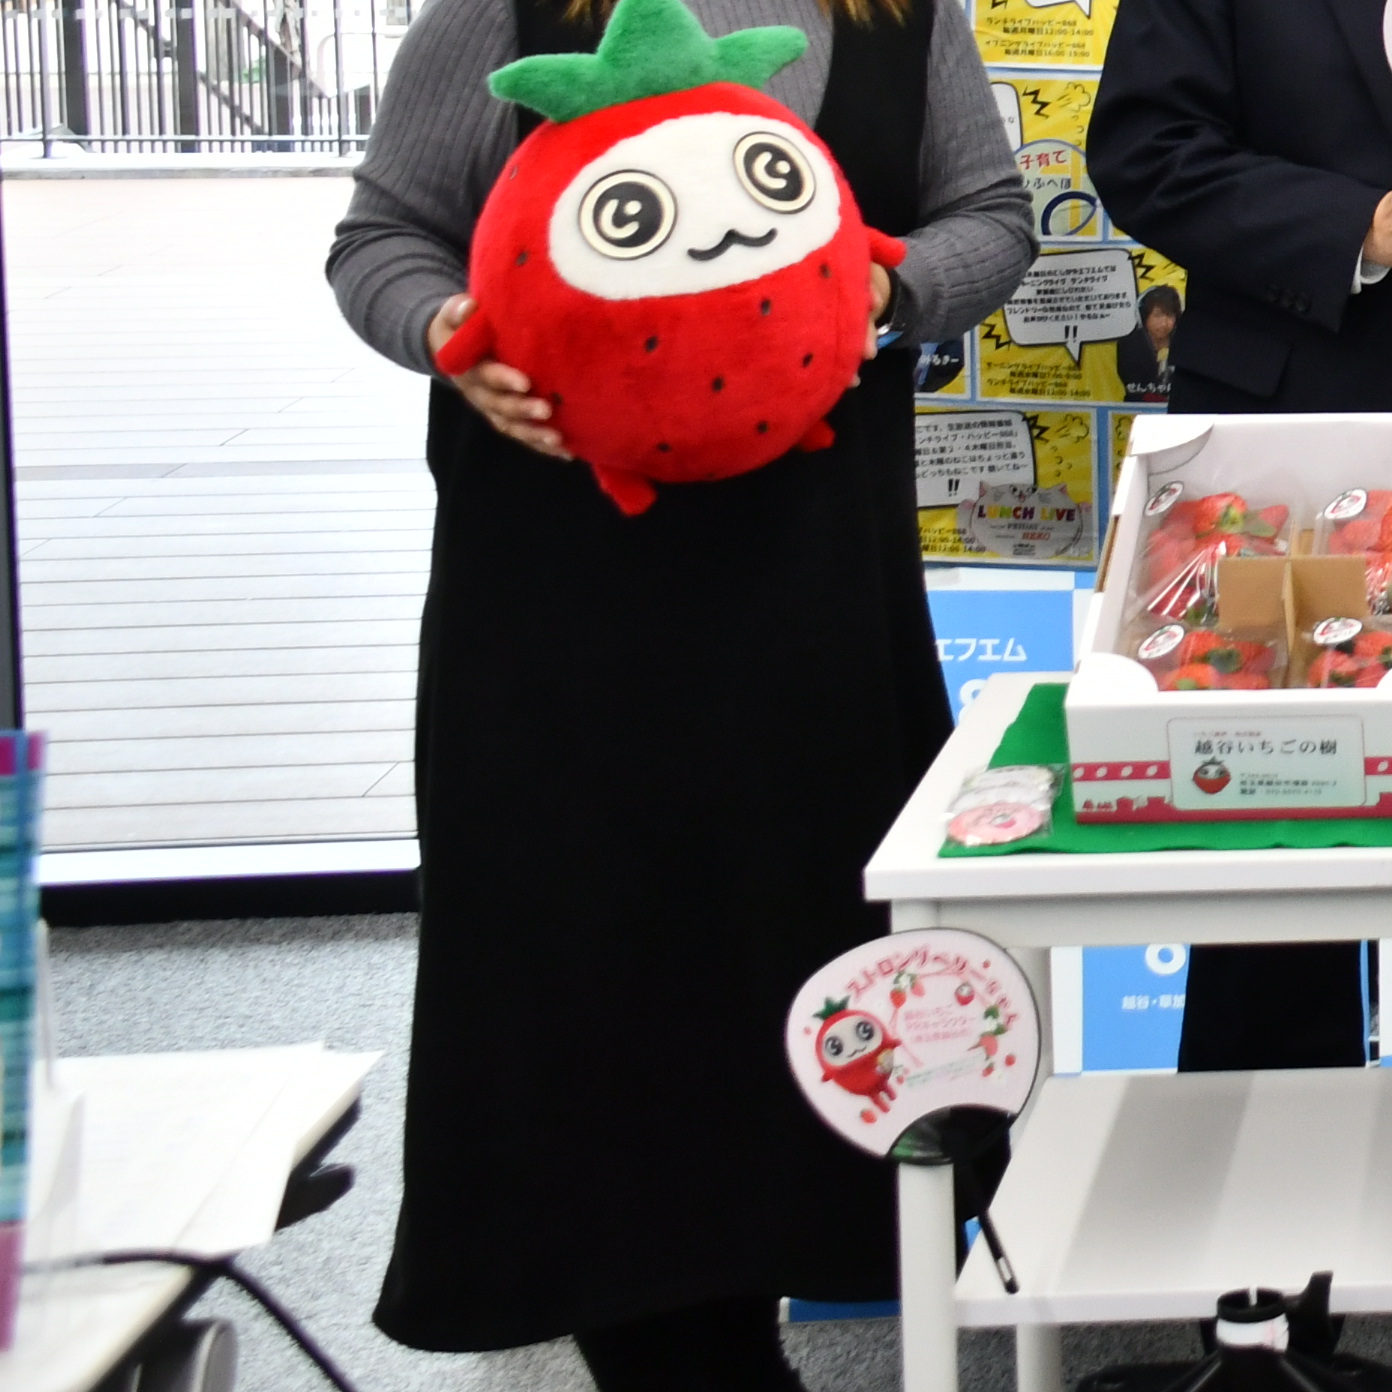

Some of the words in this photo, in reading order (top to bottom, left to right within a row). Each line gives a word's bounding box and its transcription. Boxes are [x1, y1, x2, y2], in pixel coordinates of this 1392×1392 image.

[1019, 149, 1068, 170] 子育て
[977, 504, 1036, 520] LUNCH
[1194, 739, 1338, 755] 越谷いちごの樹
